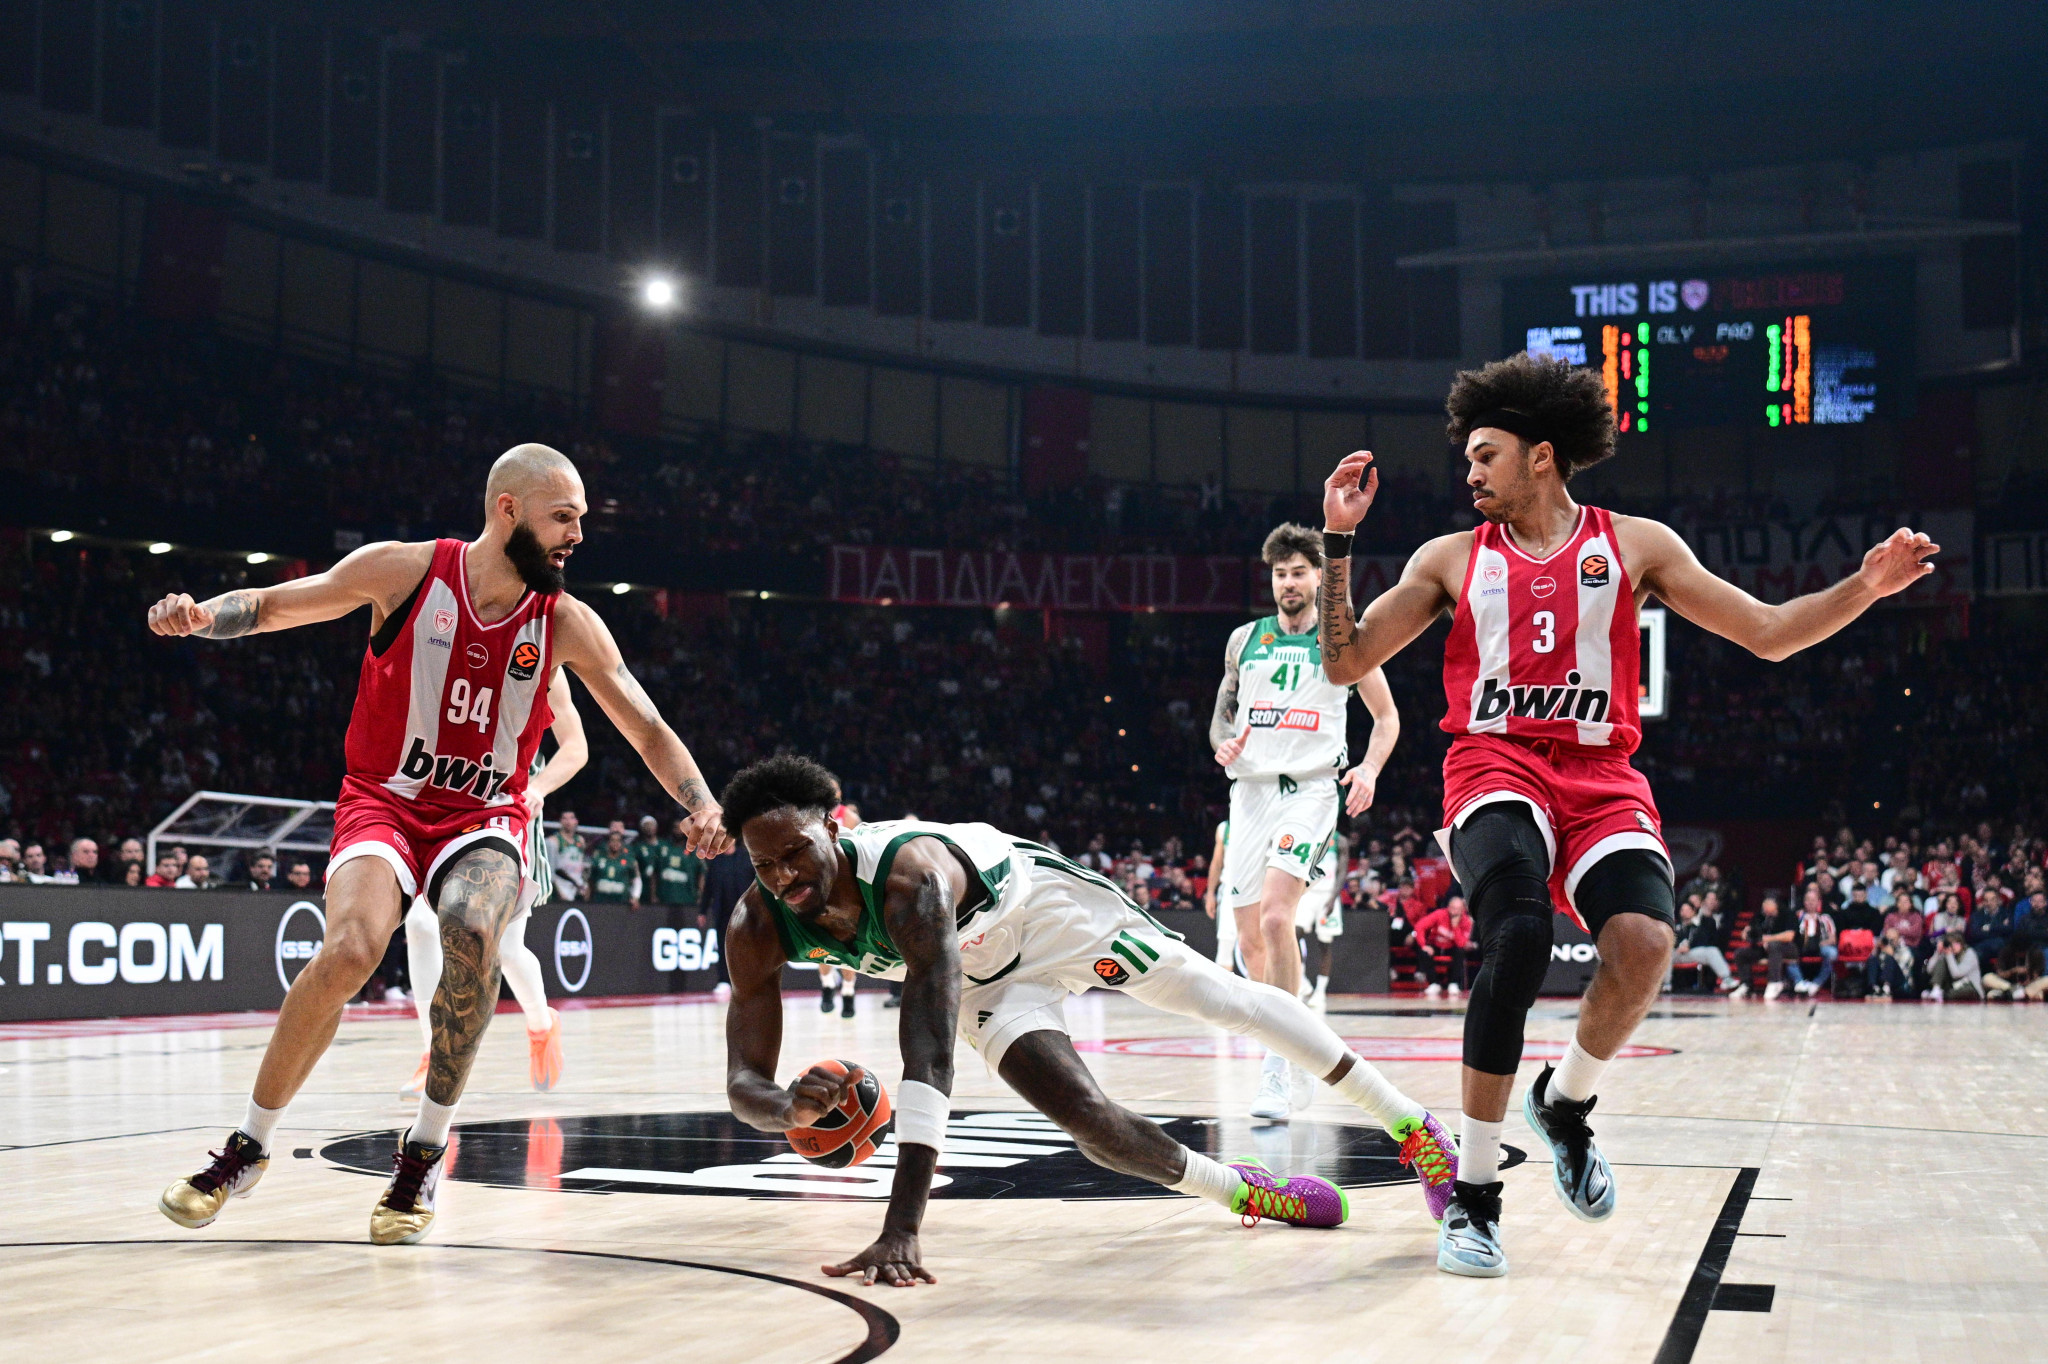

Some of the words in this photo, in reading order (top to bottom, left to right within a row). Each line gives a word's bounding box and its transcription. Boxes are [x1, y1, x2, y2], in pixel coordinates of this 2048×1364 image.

[1570, 283, 1640, 318] THIS
[1648, 280, 1679, 314] IS
[1656, 325, 1695, 345] OLY
[1532, 610, 1555, 654] 3
[1270, 663, 1301, 692] 41
[1475, 671, 1608, 722] bwin
[446, 678, 494, 734] 94
[0, 921, 224, 985] T.COM
[560, 940, 588, 957] GSA
[652, 927, 719, 971] GSA
[1110, 929, 1160, 975] 11
